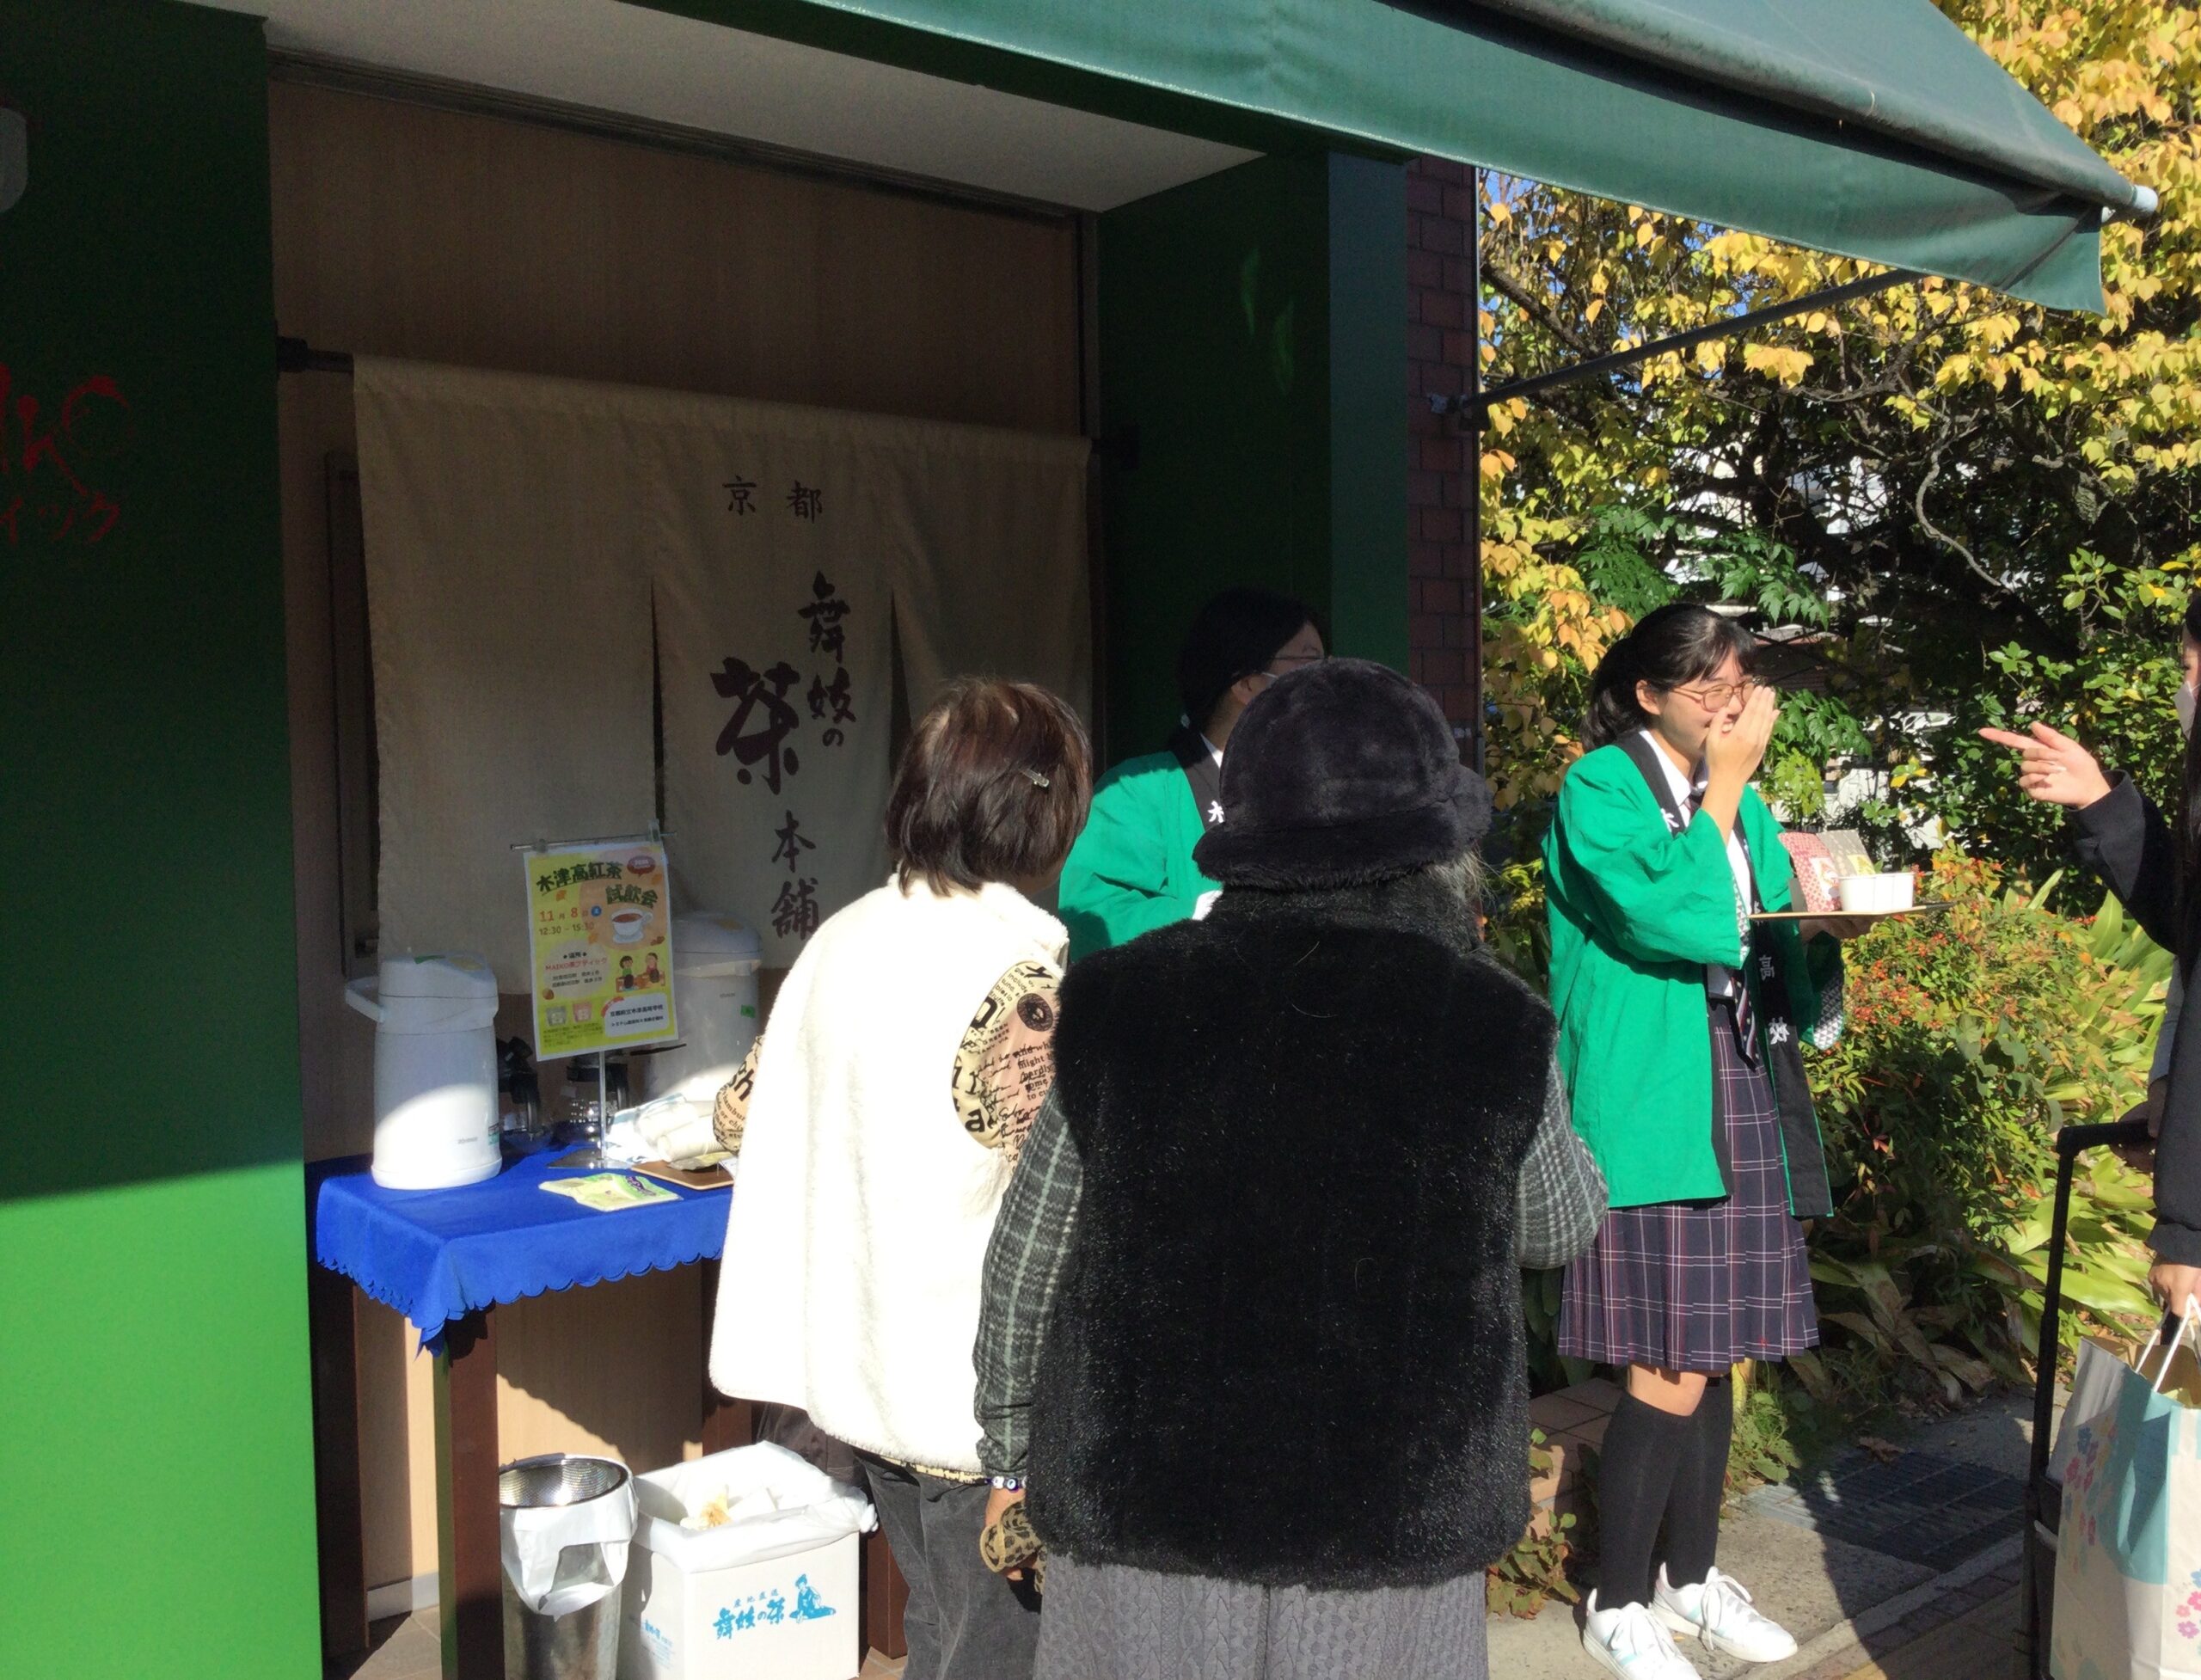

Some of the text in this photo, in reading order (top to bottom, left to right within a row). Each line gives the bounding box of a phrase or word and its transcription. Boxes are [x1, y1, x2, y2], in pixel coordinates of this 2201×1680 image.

[722, 475, 823, 524] 京都
[798, 571, 856, 747] 舞妓の
[710, 656, 800, 795] 茶
[536, 861, 623, 892] 木津高紅茶
[605, 884, 659, 908] 試飲会
[771, 809, 818, 941] 本舗
[539, 926, 561, 935] 12:30
[713, 1597, 786, 1639] 舞妓の茶
